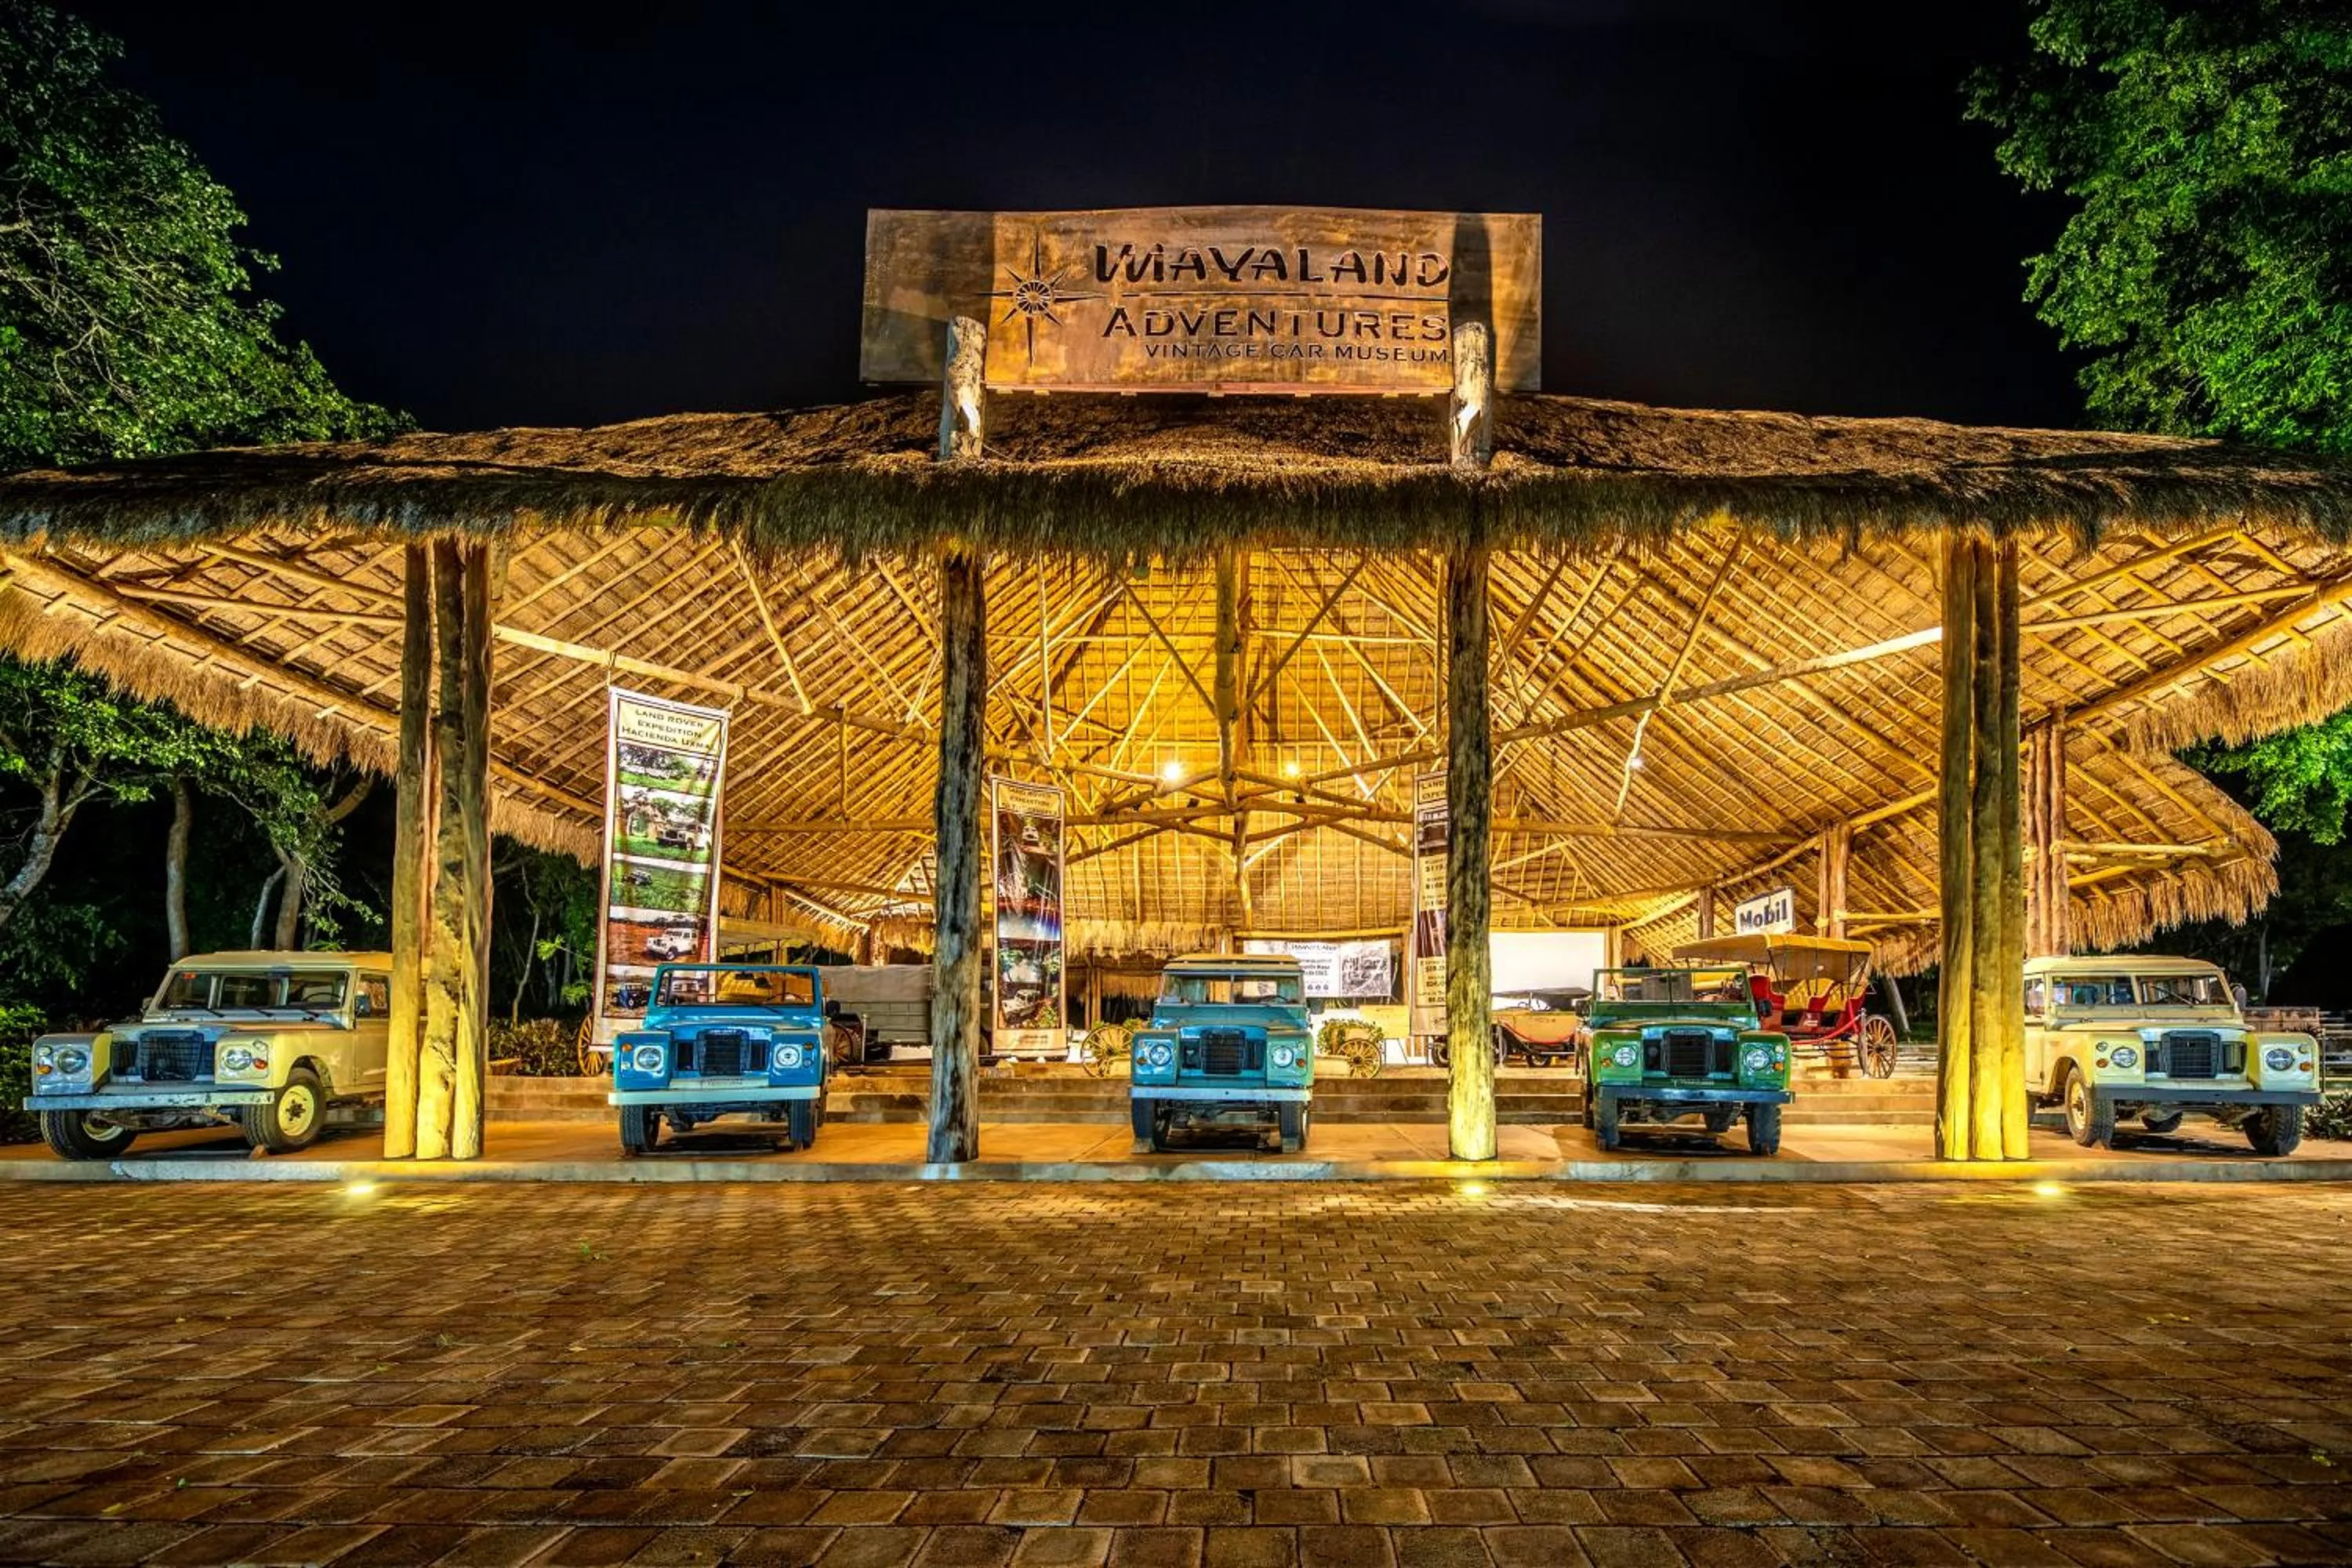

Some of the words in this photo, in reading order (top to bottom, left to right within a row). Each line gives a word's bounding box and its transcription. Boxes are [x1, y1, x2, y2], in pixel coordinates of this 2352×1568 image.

[1095, 244, 1449, 287] MAYALAND
[1102, 307, 1447, 342] ADVENTURES
[1145, 343, 1263, 358] VINTAGE
[1270, 343, 1323, 359] CAR
[1335, 345, 1448, 363] MUSEUM
[635, 708, 664, 720] LAND
[667, 715, 703, 728] ROVER
[622, 726, 678, 744] HACIENDA
[637, 719, 702, 738] EXPEDITION
[1739, 898, 1788, 930] Mobil
